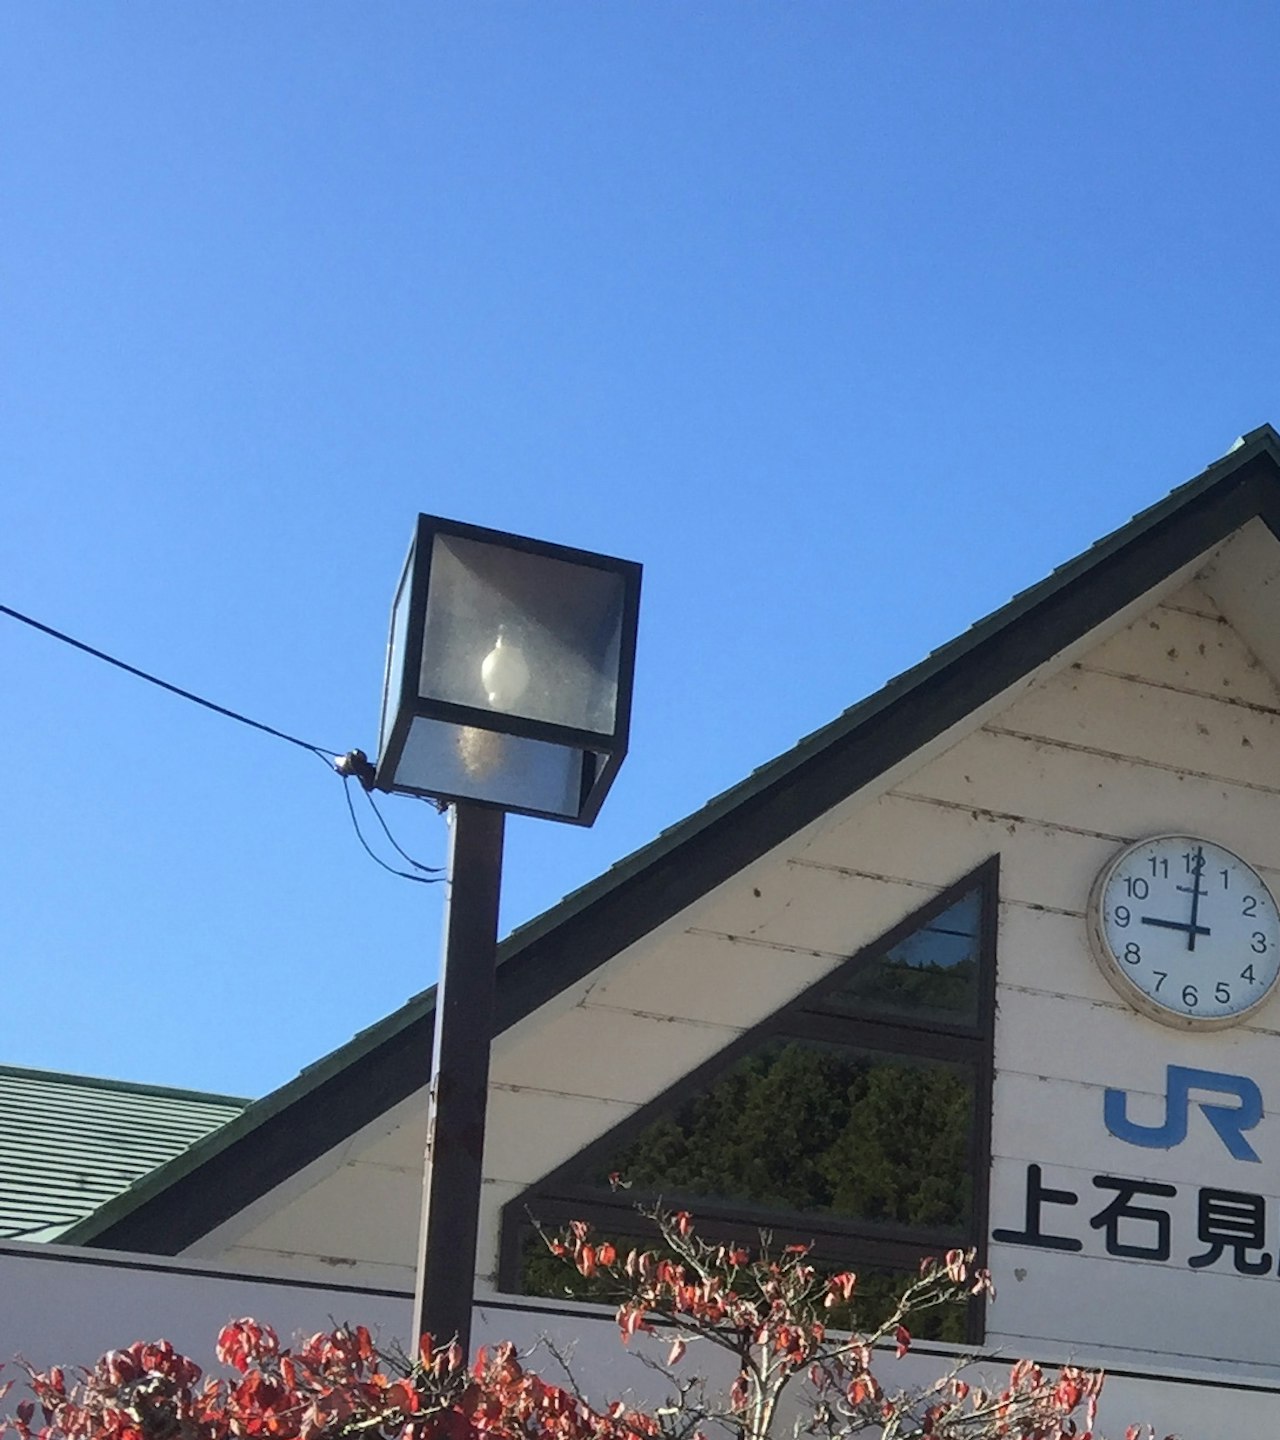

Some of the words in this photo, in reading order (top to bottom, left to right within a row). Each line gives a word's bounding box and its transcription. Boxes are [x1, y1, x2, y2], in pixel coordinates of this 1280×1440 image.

[1148, 856, 1169, 879] 11
[1182, 853, 1206, 876] 12
[1123, 876, 1149, 900] 10
[1219, 869, 1229, 890] 1
[1114, 905, 1130, 928] 9
[1242, 895, 1257, 918] 2
[1124, 942, 1141, 965] 8
[1251, 931, 1267, 954] 3
[1152, 970, 1168, 992] 7
[1240, 963, 1256, 985] 4
[1182, 985, 1198, 1007] 6
[1214, 982, 1231, 1004] 5
[1104, 1064, 1263, 1163] JR
